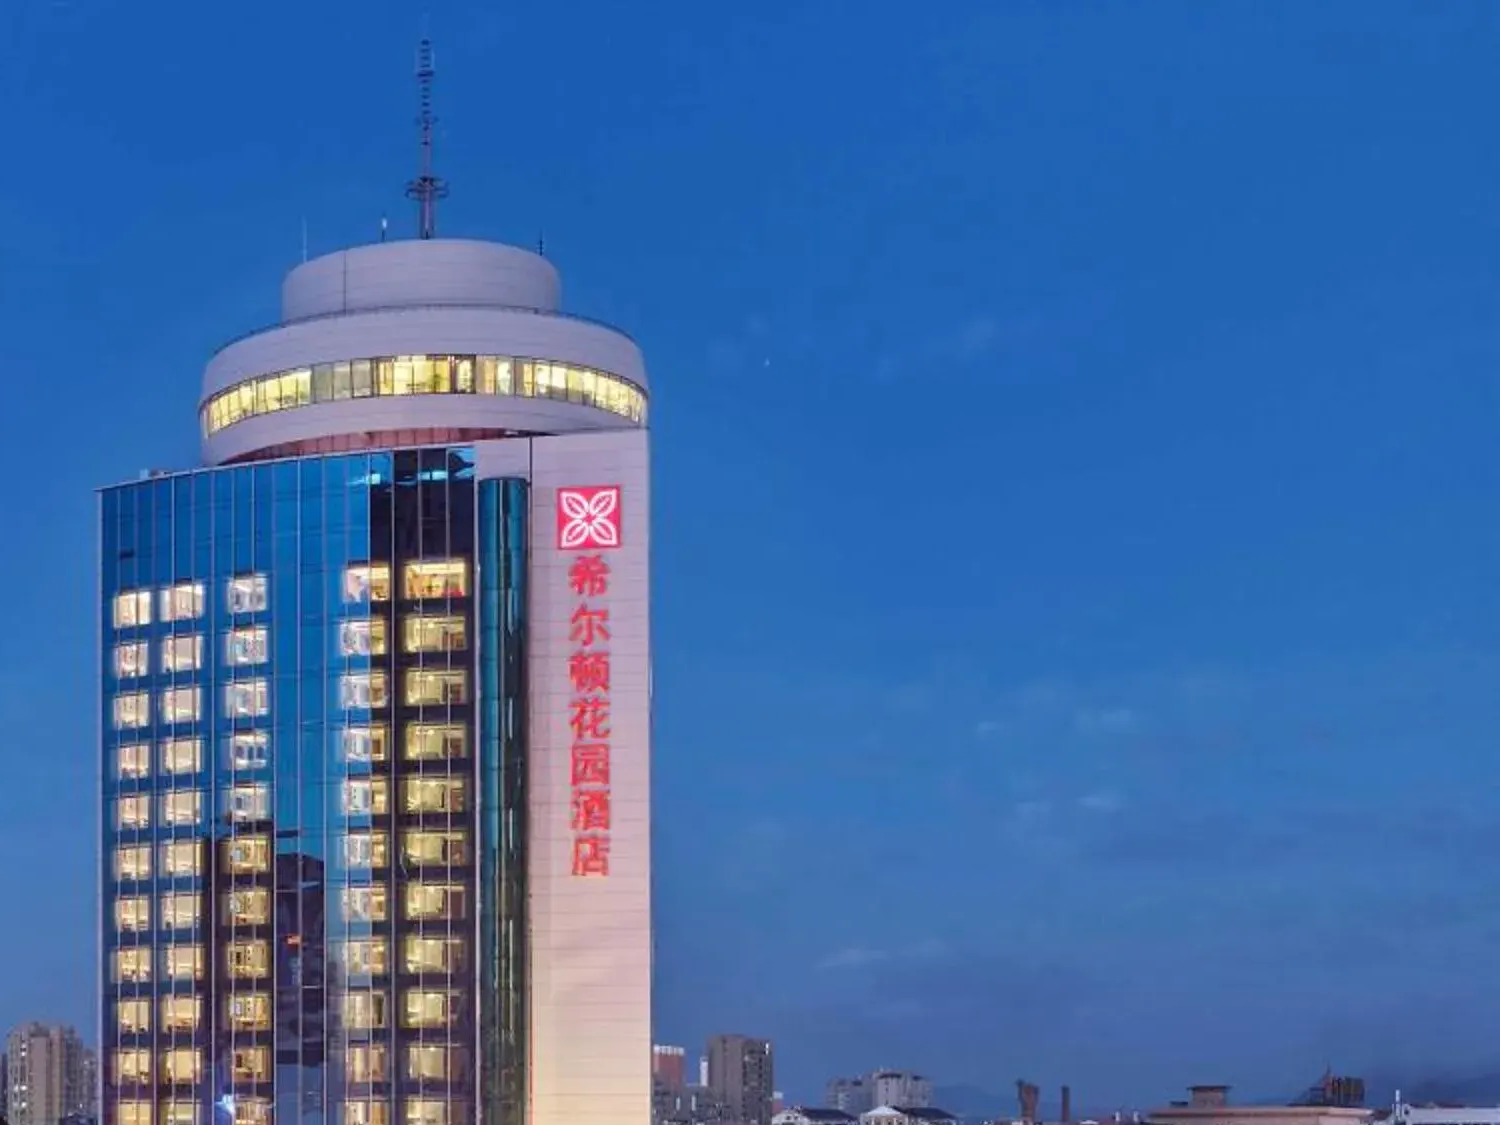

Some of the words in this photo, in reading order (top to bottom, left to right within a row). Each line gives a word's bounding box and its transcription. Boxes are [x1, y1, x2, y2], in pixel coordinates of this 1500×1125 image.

[568, 554, 611, 876] 希尔顿花园酒店
